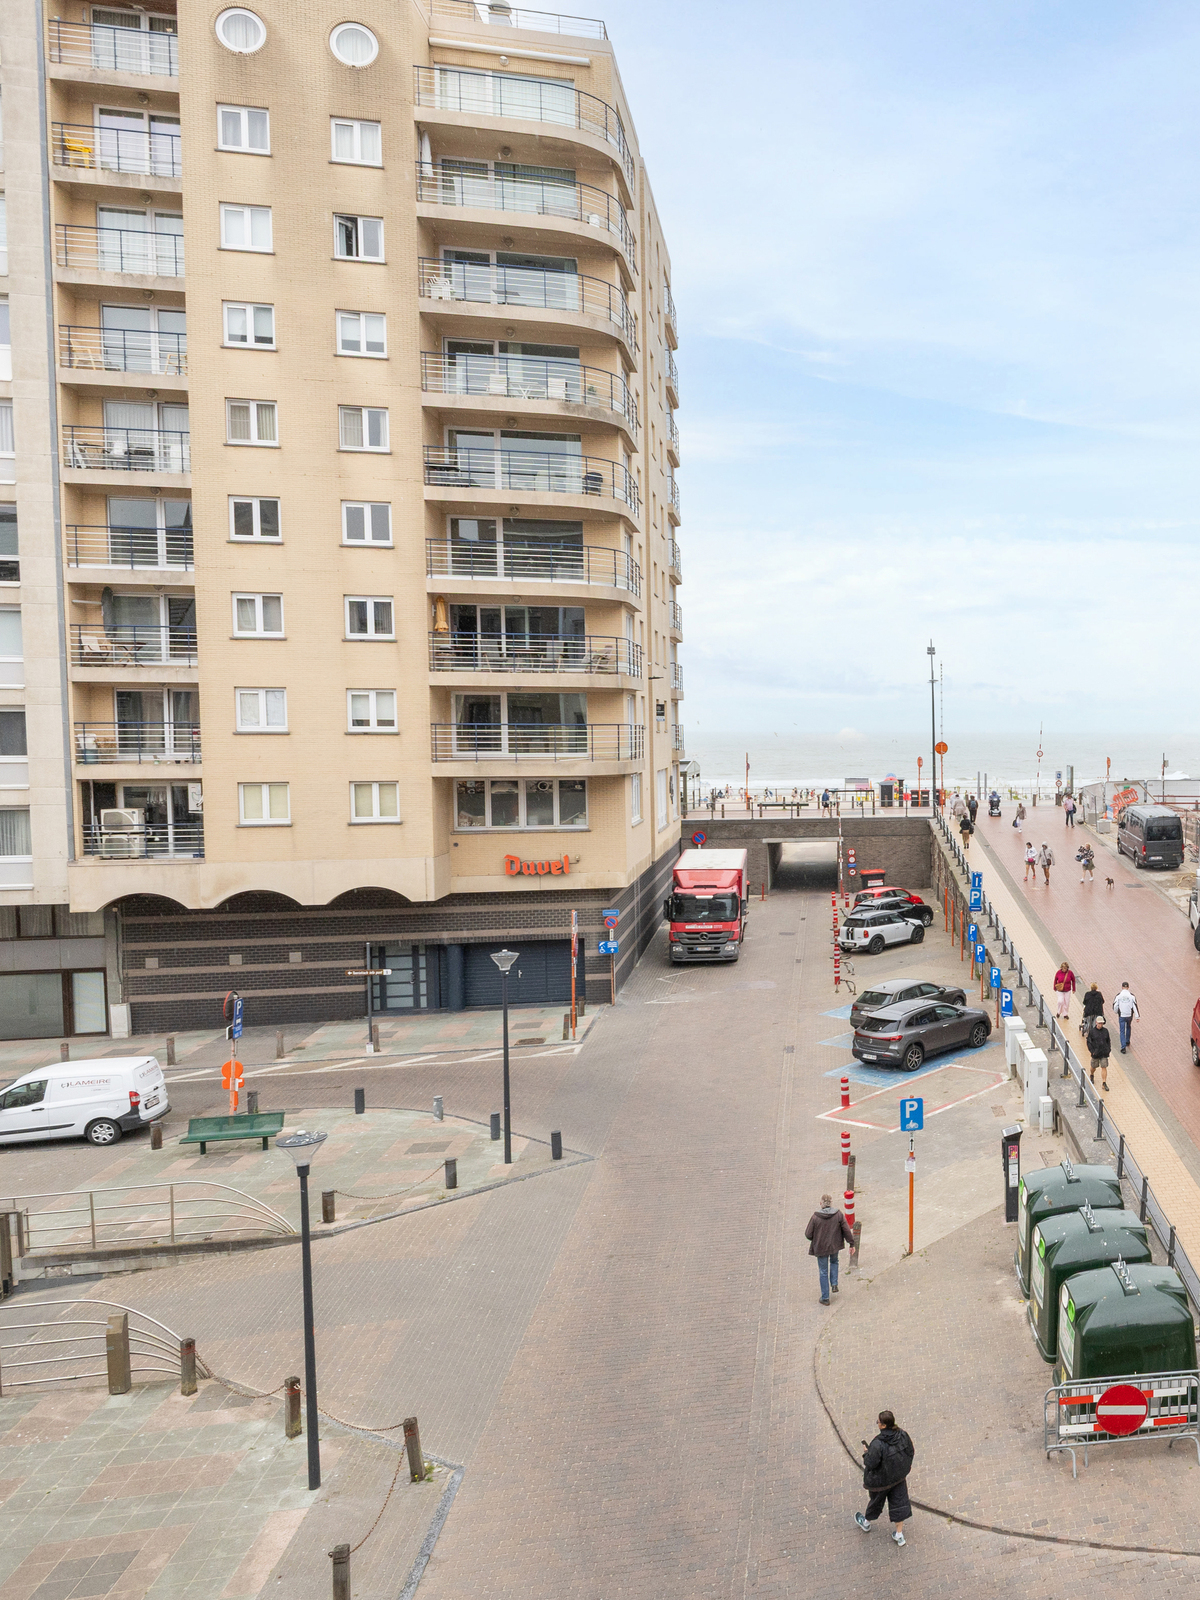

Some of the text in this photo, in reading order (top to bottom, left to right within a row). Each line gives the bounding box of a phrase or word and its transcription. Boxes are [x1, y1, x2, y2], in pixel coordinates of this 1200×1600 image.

[504, 854, 570, 876] Duvel
[971, 891, 980, 904] P
[969, 925, 976, 935] P
[977, 945, 983, 955] P
[992, 968, 999, 980] P
[1002, 992, 1011, 1008] P
[905, 1100, 918, 1119] P
